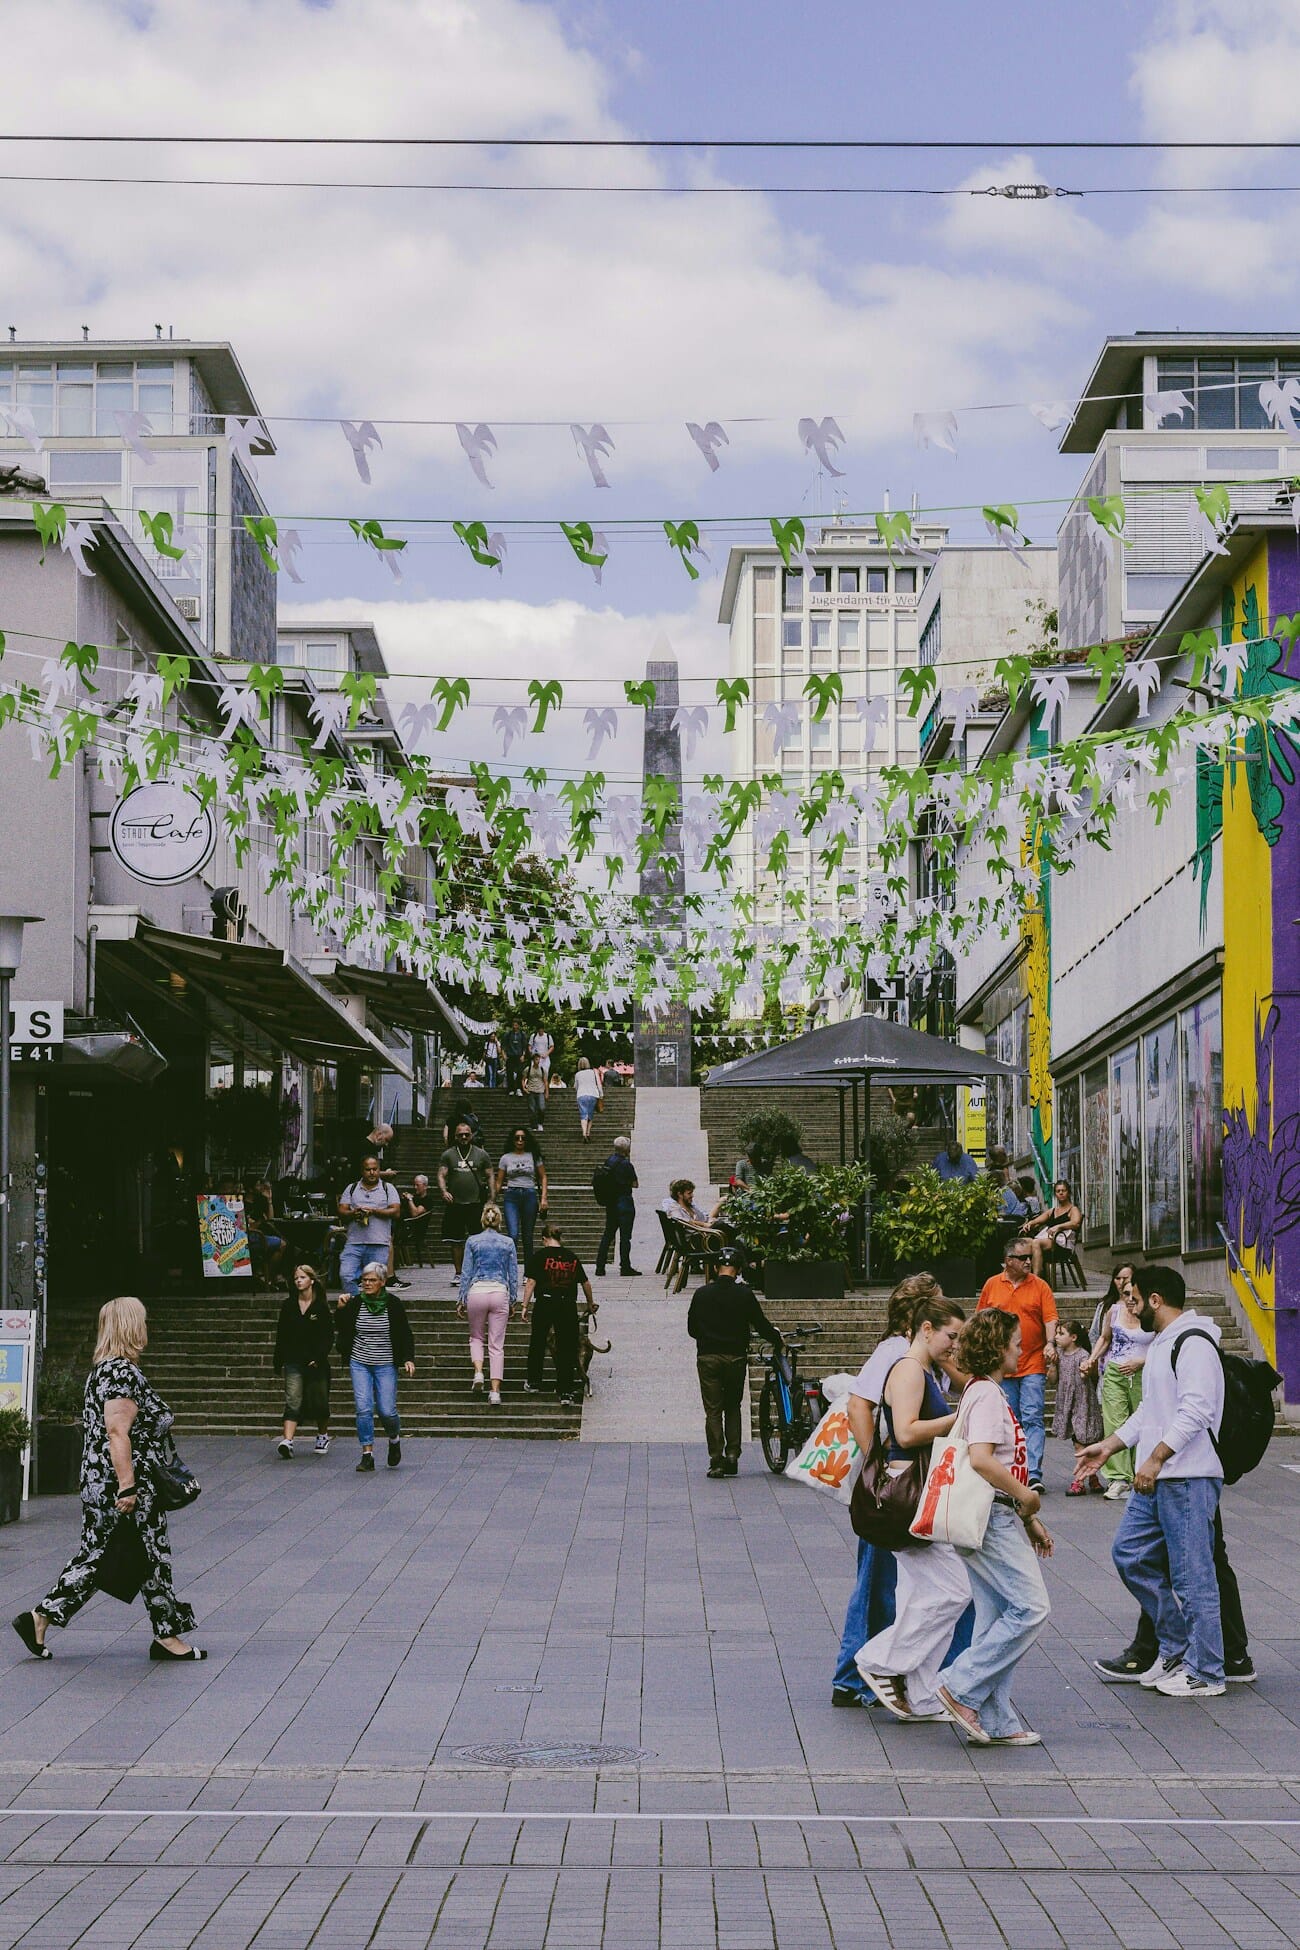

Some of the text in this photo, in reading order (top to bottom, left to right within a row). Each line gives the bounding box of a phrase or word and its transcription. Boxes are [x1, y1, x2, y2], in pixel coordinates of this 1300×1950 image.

[811, 595, 873, 606] Jugendamt
[876, 595, 891, 605] für
[833, 1054, 898, 1065] fritz-kola
[211, 1229, 235, 1246] STADT
